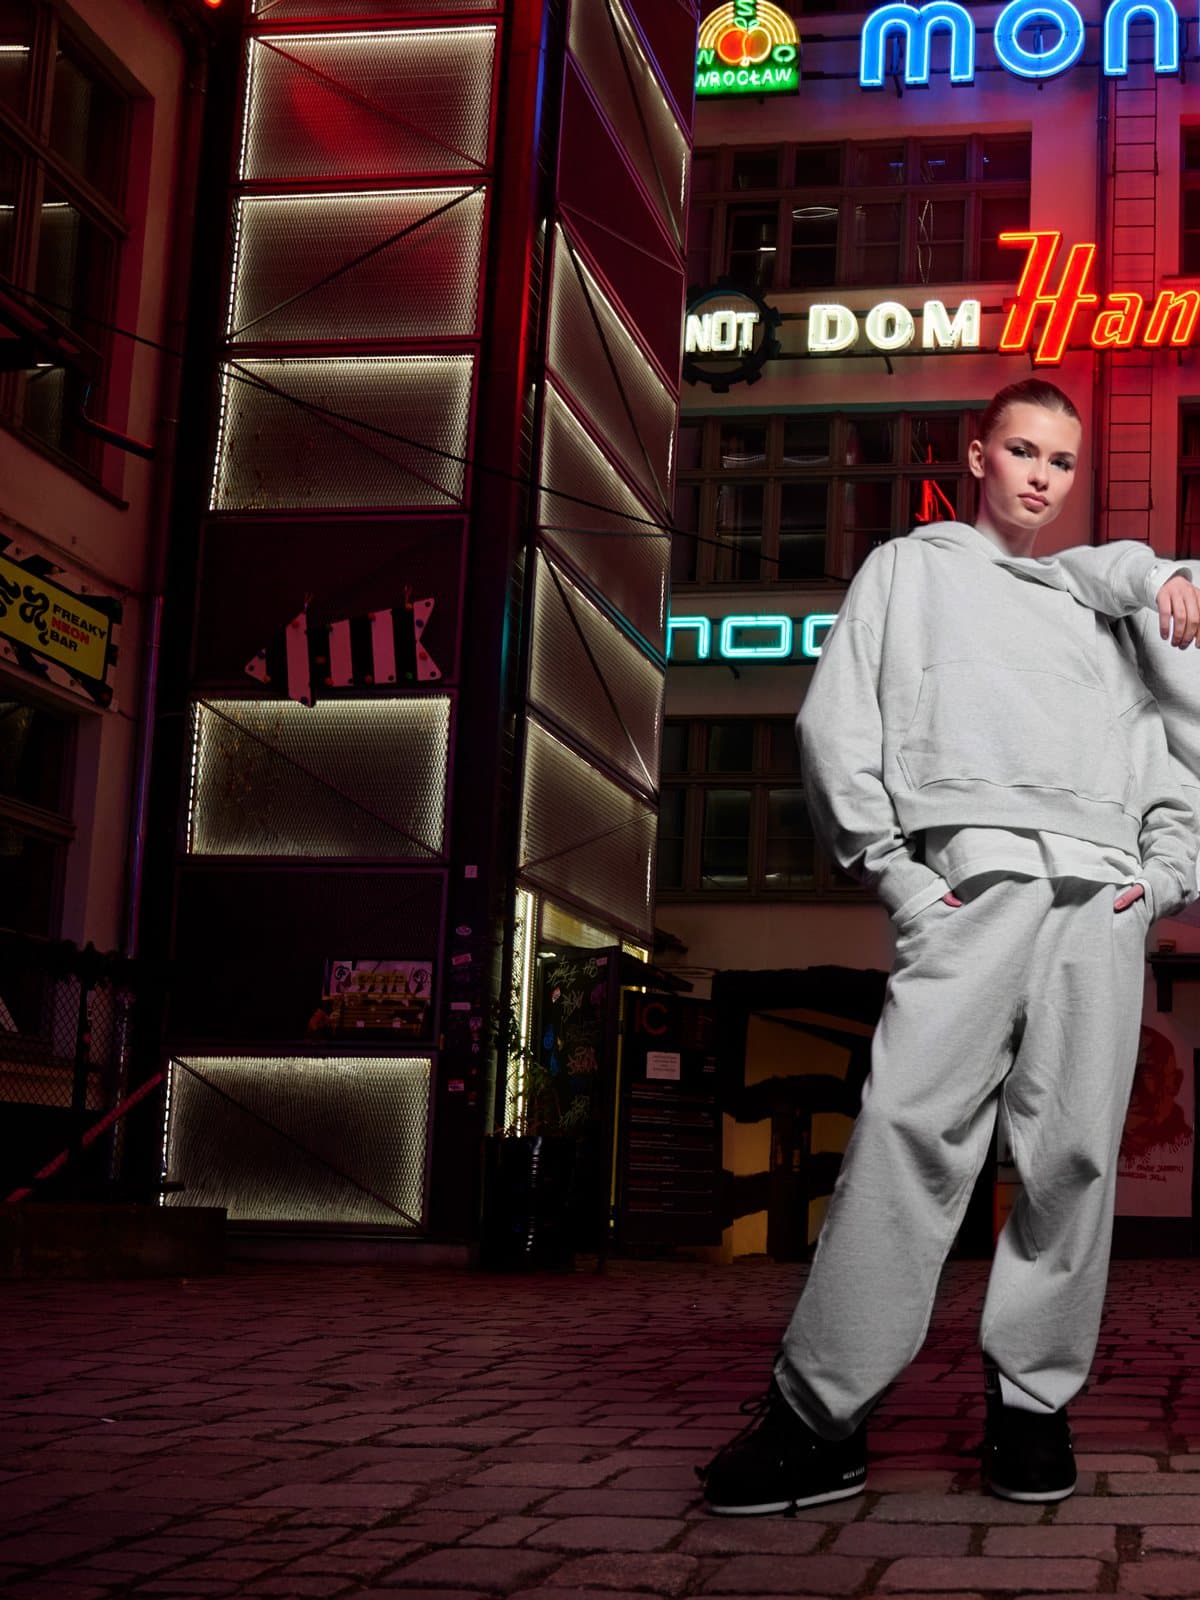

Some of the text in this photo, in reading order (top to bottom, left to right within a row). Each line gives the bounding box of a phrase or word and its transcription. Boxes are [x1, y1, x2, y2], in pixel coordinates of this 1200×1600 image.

[695, 67, 793, 88] WROCŁAW
[684, 309, 761, 353] NOT
[807, 299, 982, 353] DOM
[51, 615, 91, 645] NEON
[52, 604, 107, 641] FREAKY
[50, 631, 78, 652] BAR
